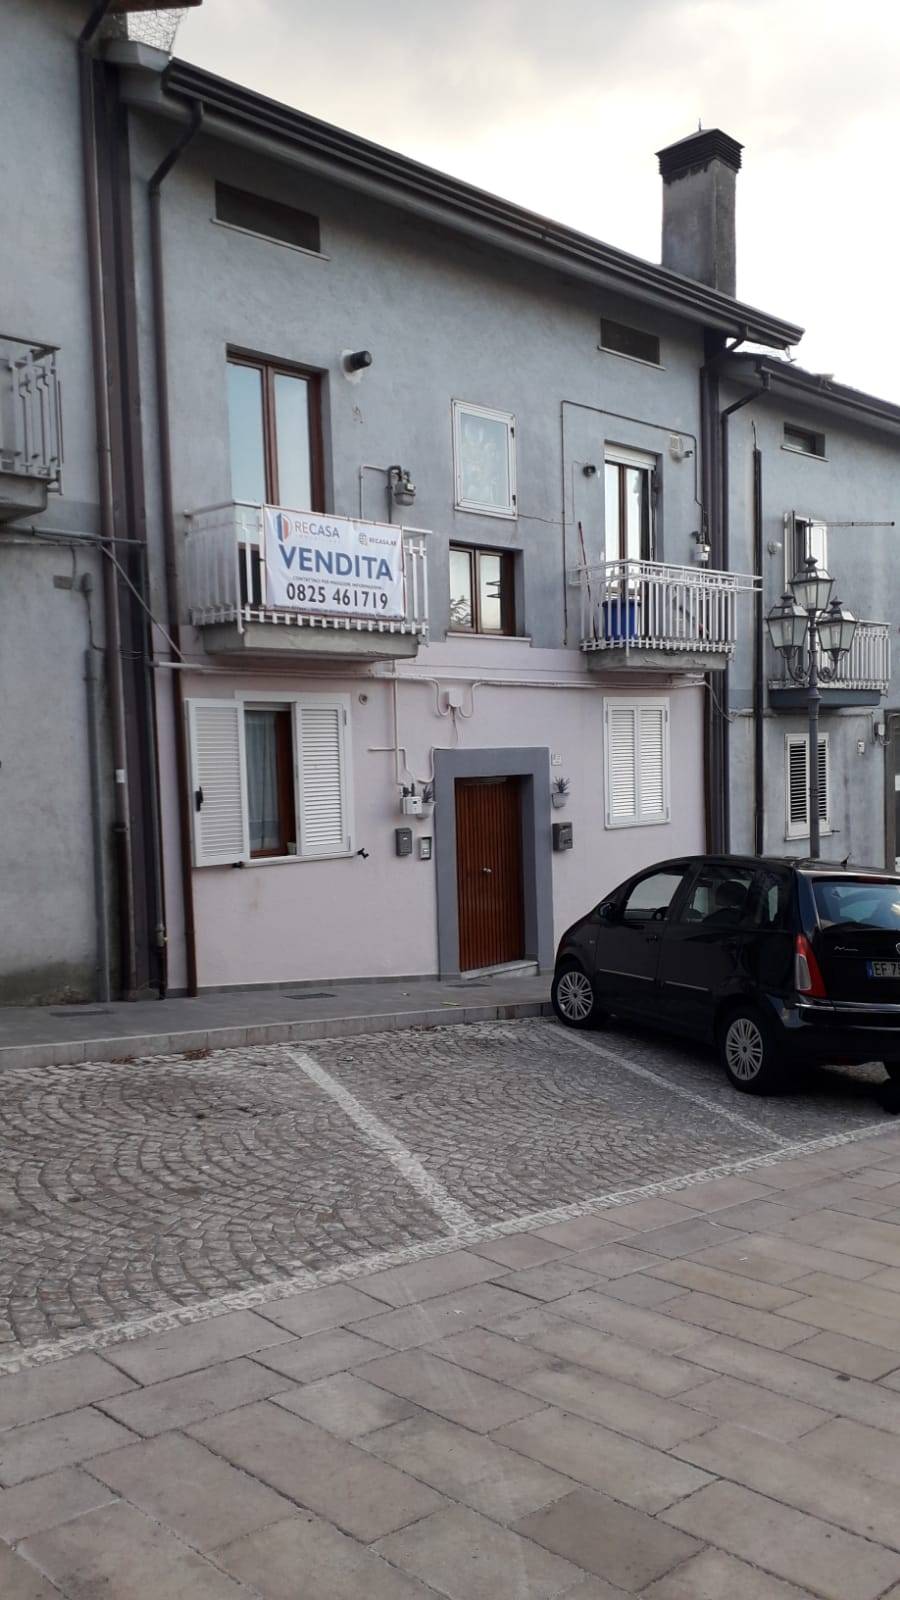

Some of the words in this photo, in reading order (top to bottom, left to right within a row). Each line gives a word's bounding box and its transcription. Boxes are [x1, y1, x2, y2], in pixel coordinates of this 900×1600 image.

[294, 521, 340, 539] RECASA
[279, 544, 393, 582] VENDITA
[287, 583, 326, 604] 0825
[332, 588, 388, 610] 461719
